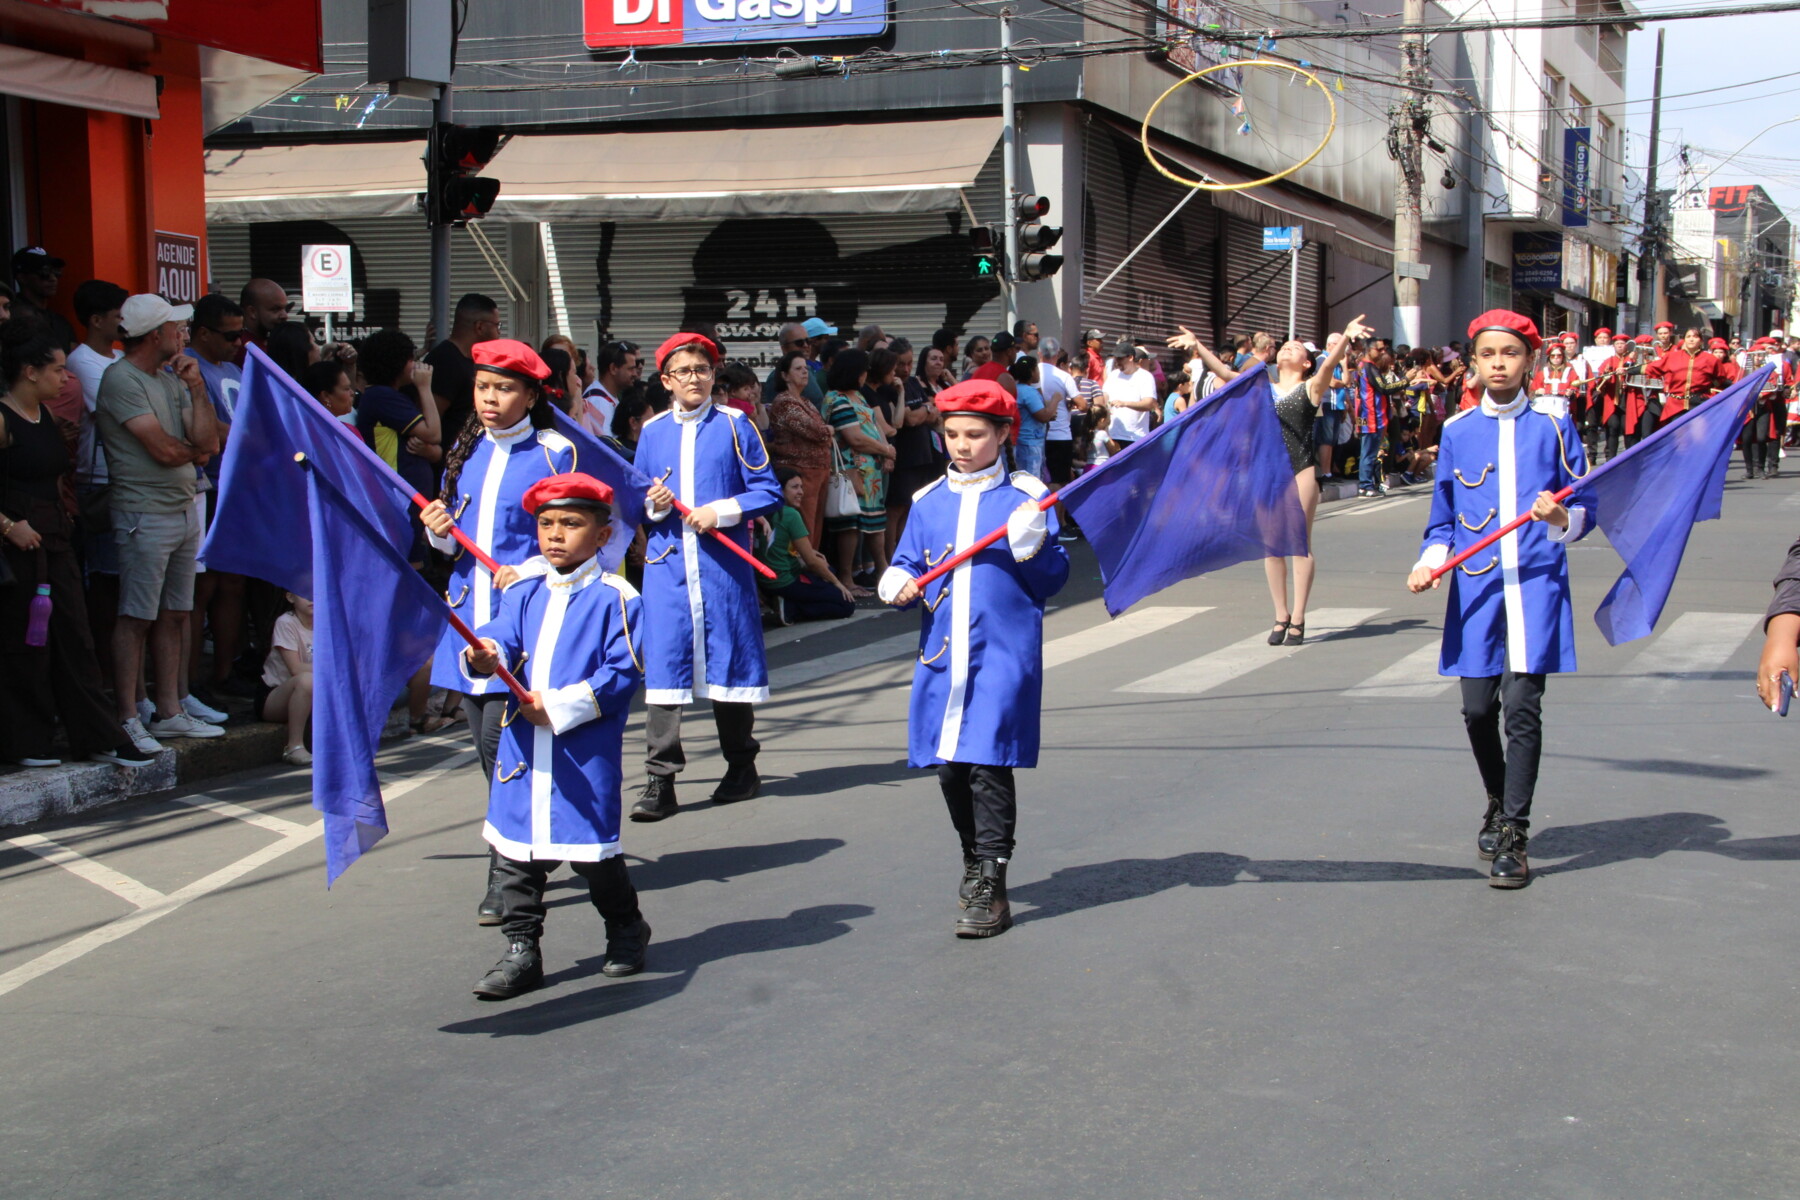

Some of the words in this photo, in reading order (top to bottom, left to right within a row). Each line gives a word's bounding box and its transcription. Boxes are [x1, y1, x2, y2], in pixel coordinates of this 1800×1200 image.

[1709, 185, 1754, 206] FIT
[157, 242, 196, 266] AGENDE
[320, 253, 332, 271] E
[159, 267, 196, 302] AQUI
[726, 288, 817, 318] 24H
